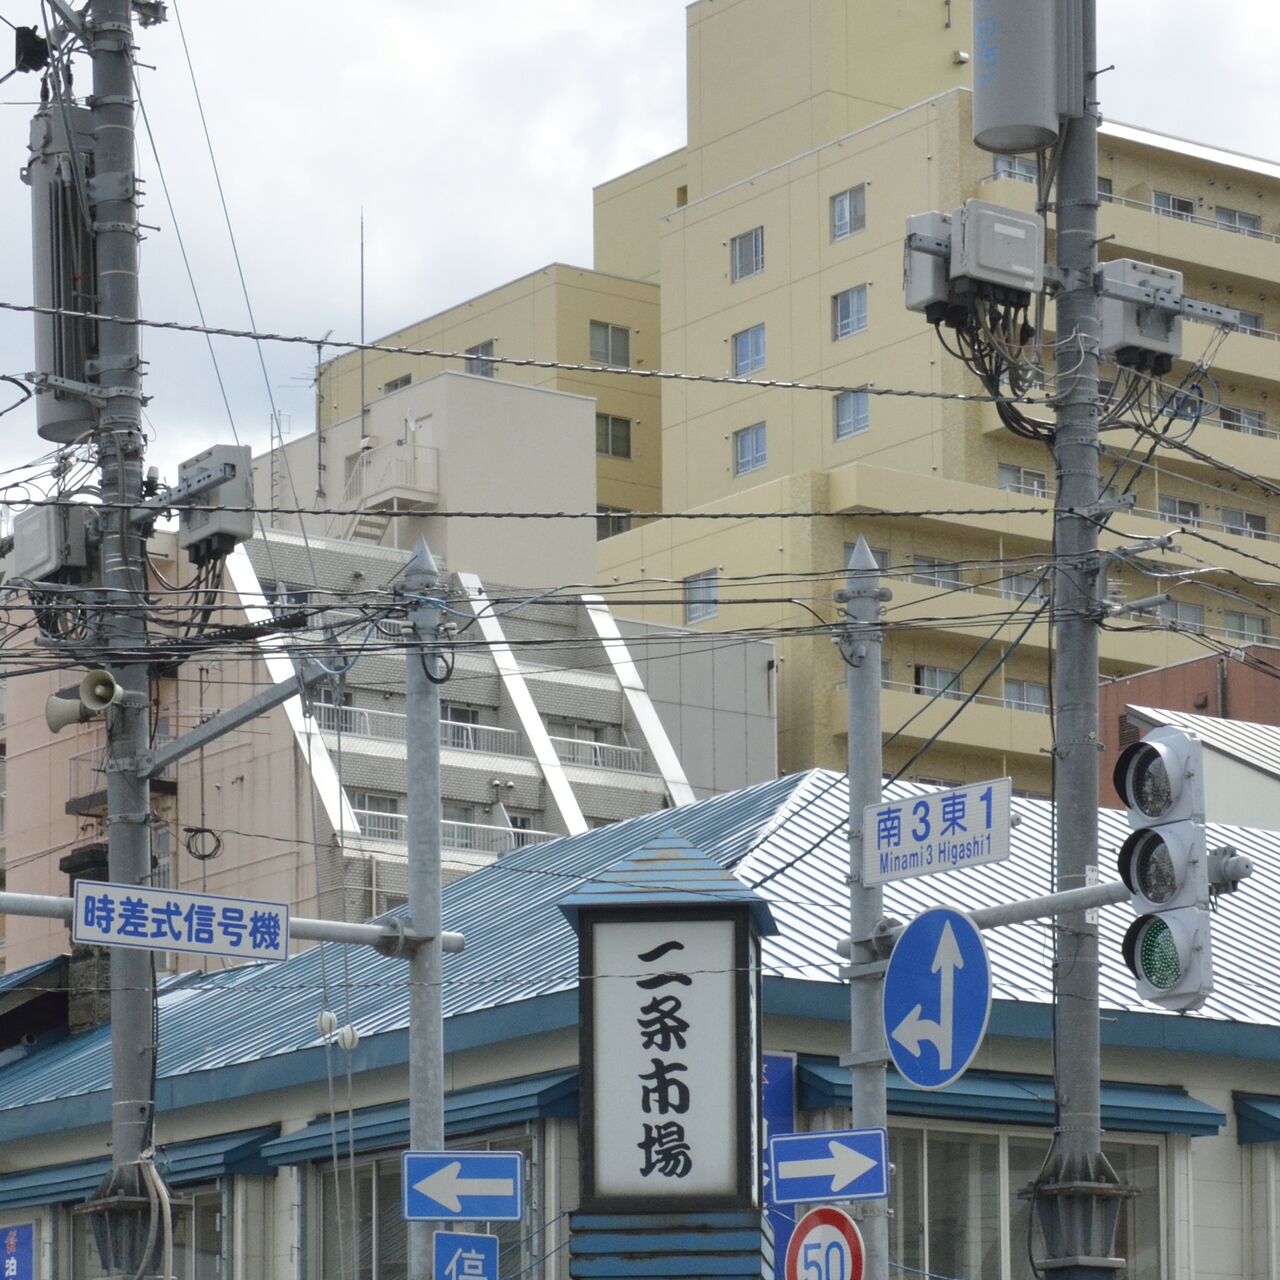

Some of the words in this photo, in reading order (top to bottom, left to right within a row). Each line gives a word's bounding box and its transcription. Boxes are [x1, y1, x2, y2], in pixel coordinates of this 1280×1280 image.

[876, 786, 993, 850] 南3東1
[880, 847, 923, 874] Minami
[926, 844, 933, 865] 3
[938, 834, 984, 865] Higashi
[986, 833, 992, 855] 1
[84, 894, 281, 951] 時差式信号機
[637, 940, 692, 1179] 二条市場
